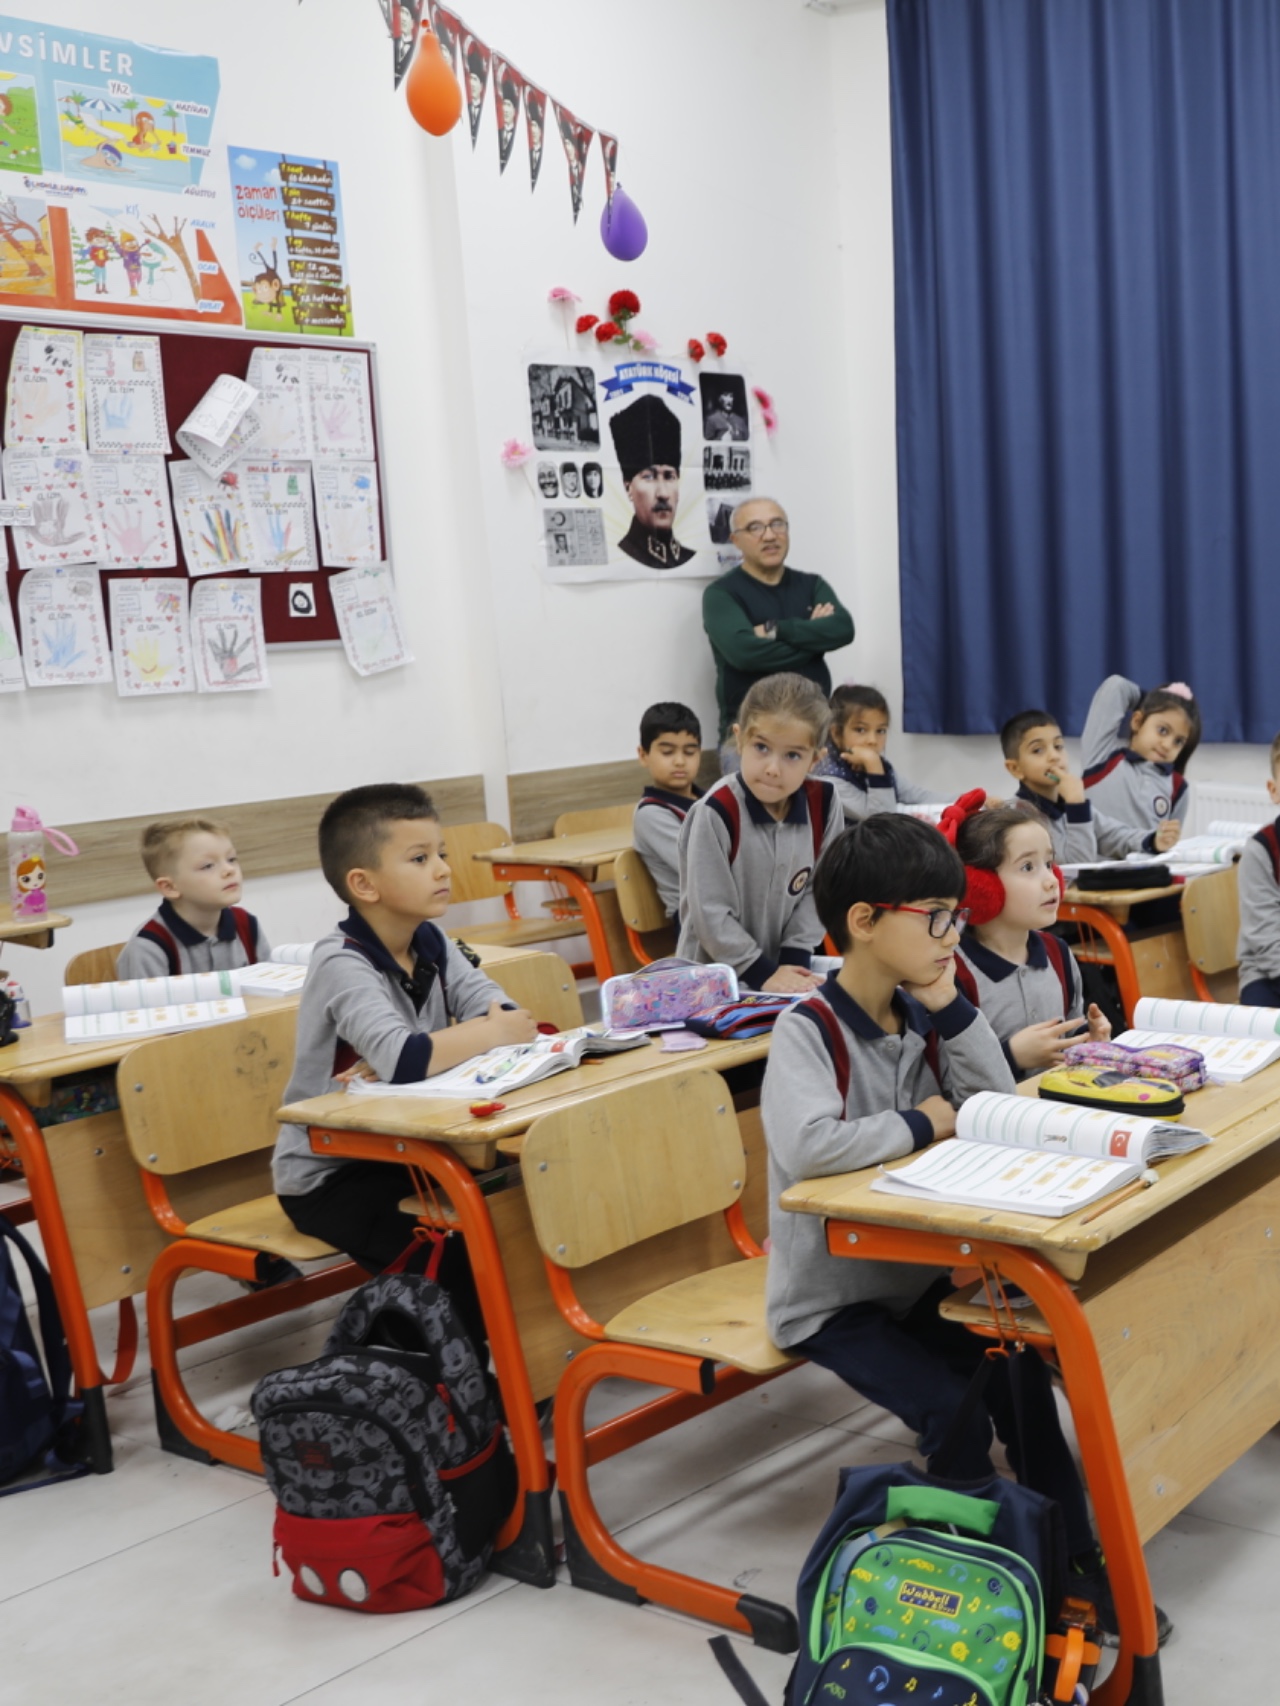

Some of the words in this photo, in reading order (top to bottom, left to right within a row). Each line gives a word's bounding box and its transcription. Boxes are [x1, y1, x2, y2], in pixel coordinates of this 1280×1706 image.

[110, 82, 130, 96] YAZ
[175, 102, 209, 115] HAZİRAN
[182, 145, 211, 157] TEMMUZ
[184, 187, 216, 198] AĞUSTOS
[236, 185, 277, 200] zaman
[126, 204, 140, 219] KIŞ
[238, 202, 280, 223] ölçüleri
[191, 219, 216, 229] ARALIK
[198, 263, 217, 272] OCAK
